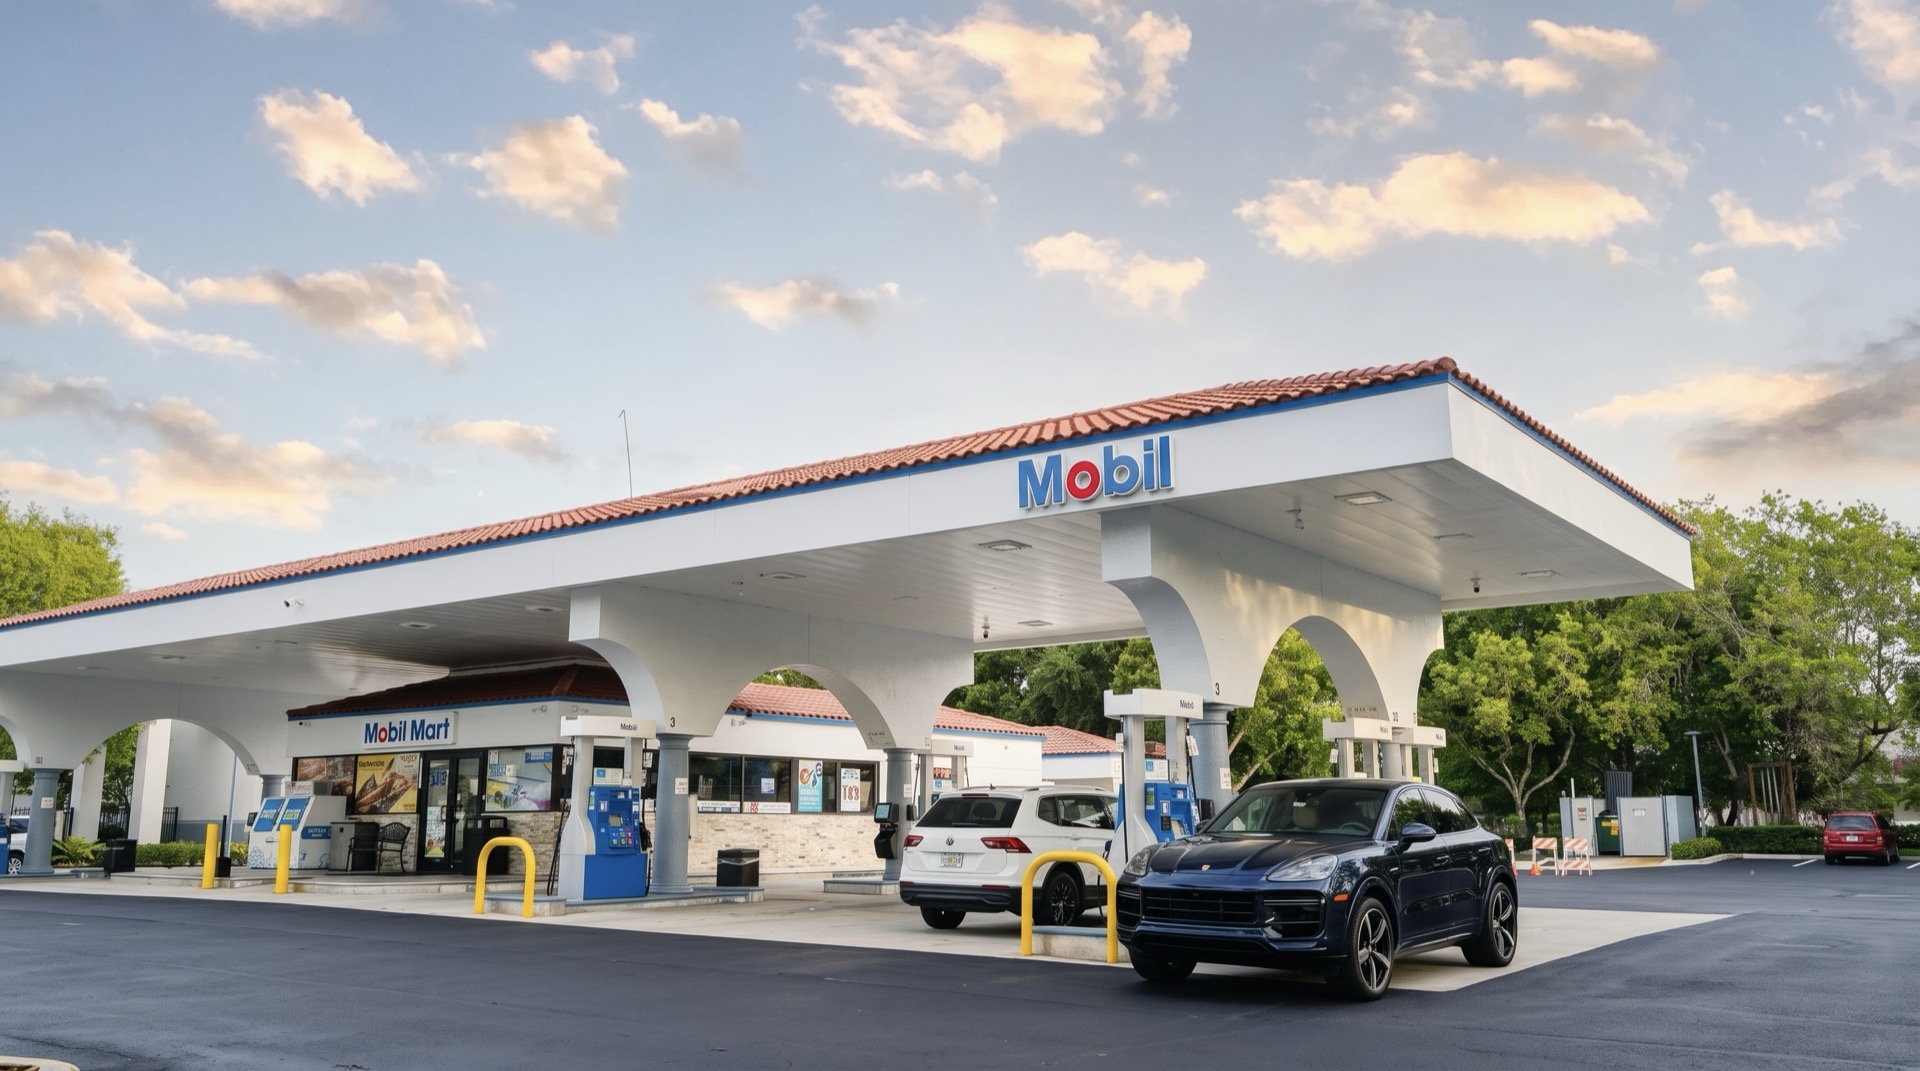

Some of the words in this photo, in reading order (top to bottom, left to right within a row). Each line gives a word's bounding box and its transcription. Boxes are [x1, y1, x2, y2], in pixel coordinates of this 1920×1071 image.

[1018, 434, 1174, 509] Mobil
[1215, 682, 1220, 696] 3
[364, 720, 407, 744] Mobil
[410, 717, 450, 741] Mart
[670, 717, 676, 728] 3
